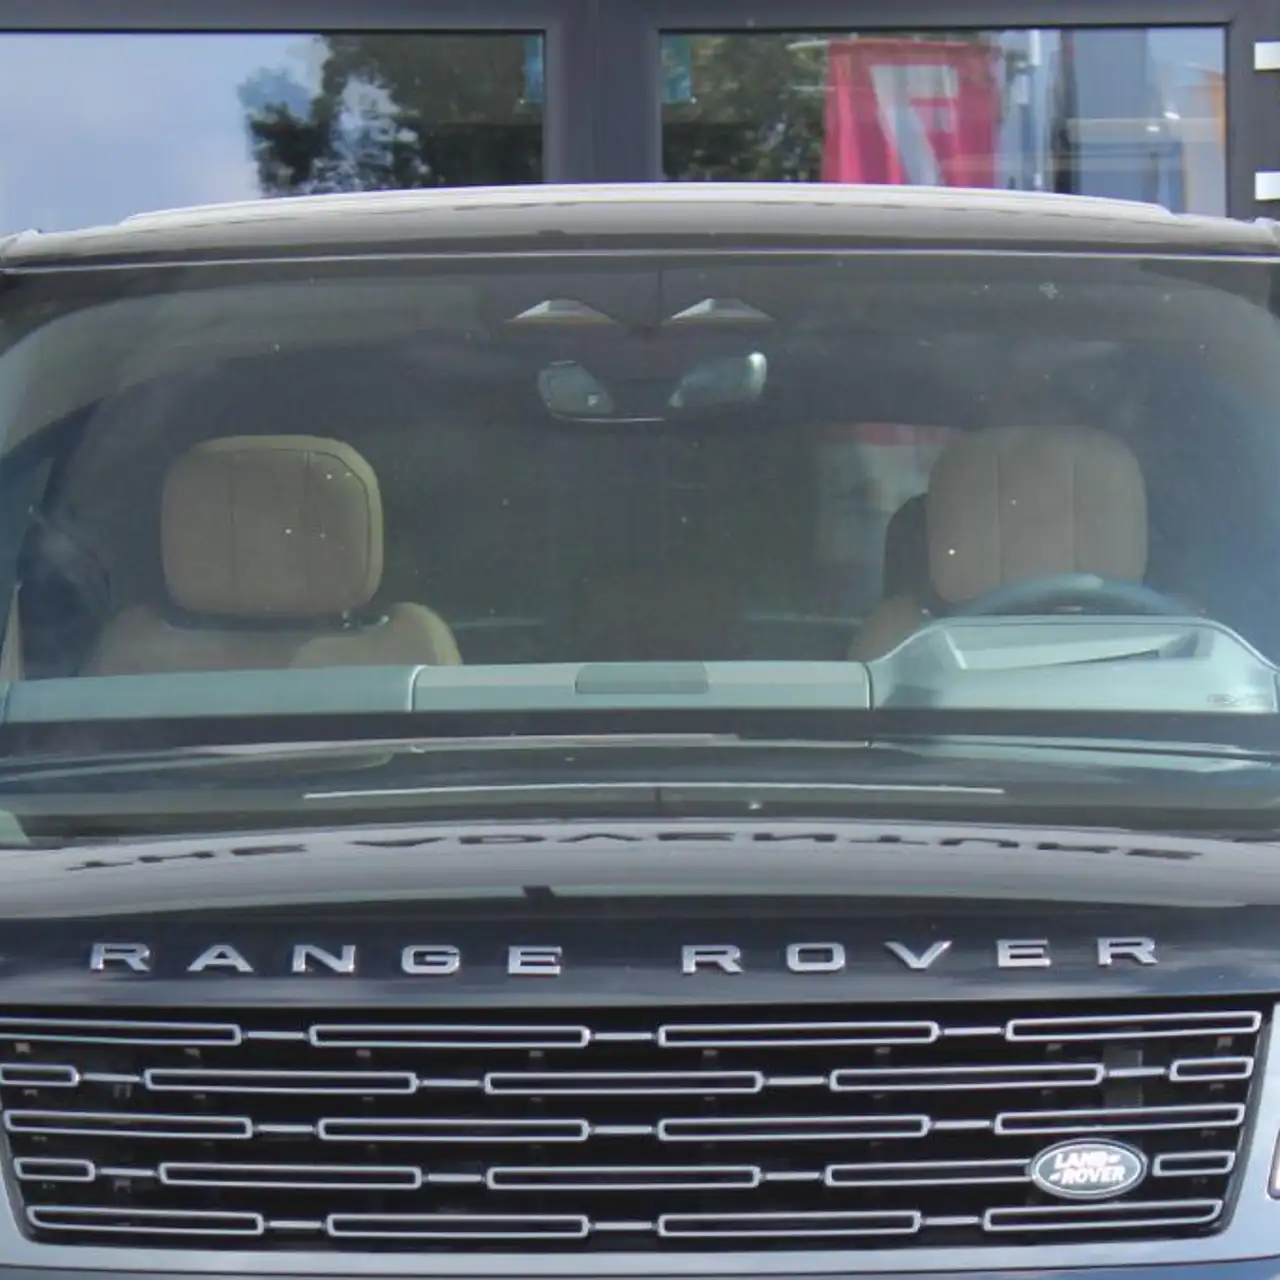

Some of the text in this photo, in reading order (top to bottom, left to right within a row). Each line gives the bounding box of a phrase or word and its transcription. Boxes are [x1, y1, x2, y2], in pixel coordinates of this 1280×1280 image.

[90, 936, 1159, 976] RANGE ROVER
[1053, 1151, 1109, 1169] LAND
[1059, 1165, 1126, 1185] ROVER
